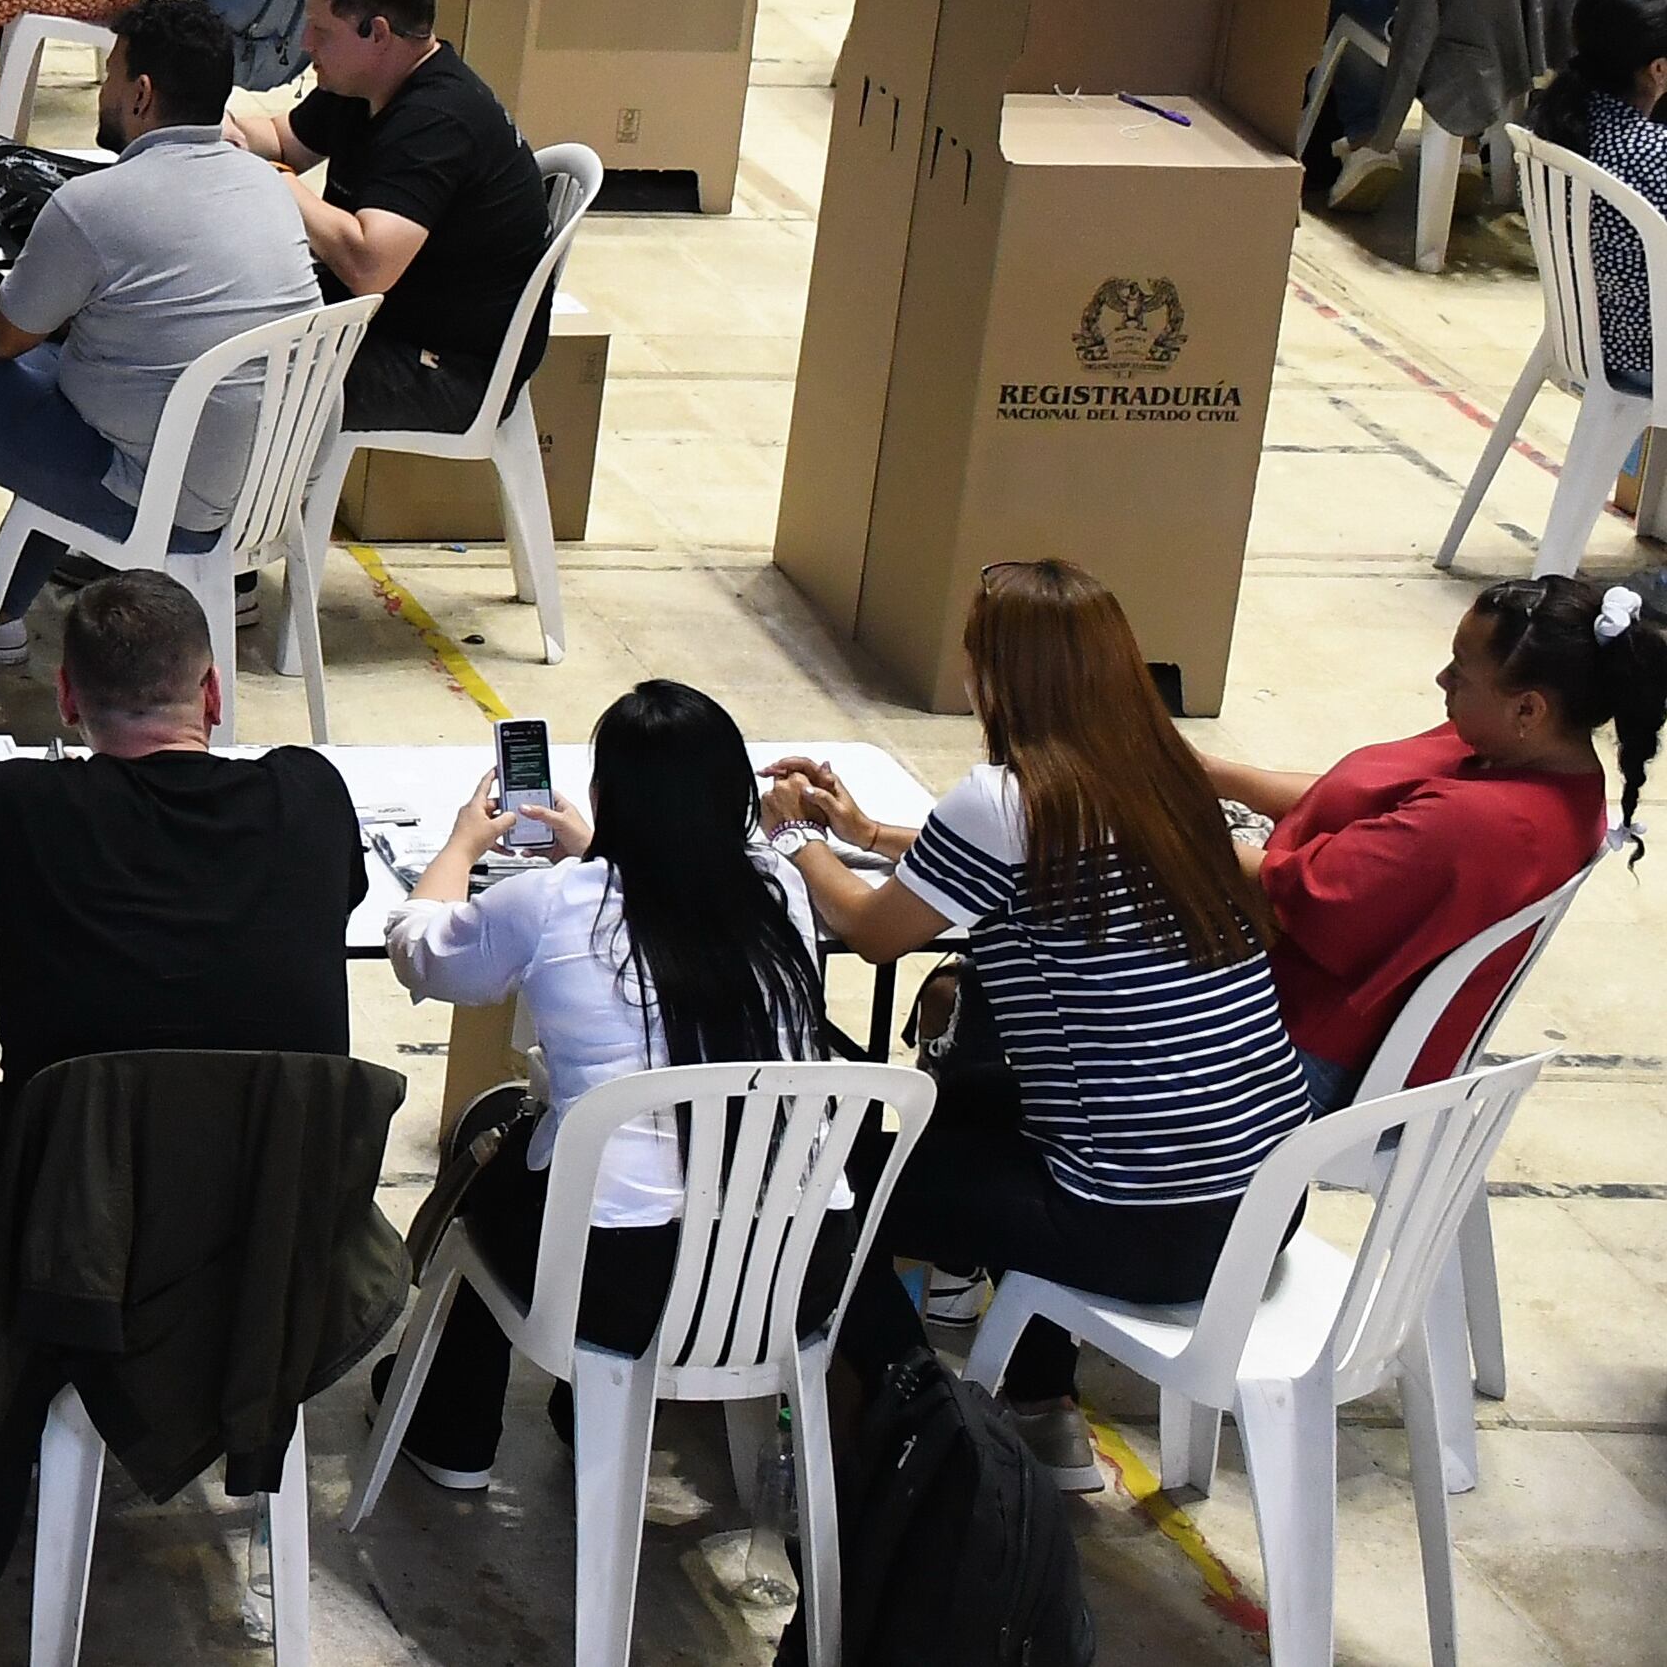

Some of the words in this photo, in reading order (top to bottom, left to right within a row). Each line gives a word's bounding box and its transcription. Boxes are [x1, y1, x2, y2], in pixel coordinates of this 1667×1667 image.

[998, 380, 1242, 407] REGISTRADURÍA
[996, 407, 1078, 420] NACIONAL
[1086, 409, 1120, 421] DEL
[1125, 409, 1191, 421] ESTADO
[1196, 410, 1240, 422] CIVIL
